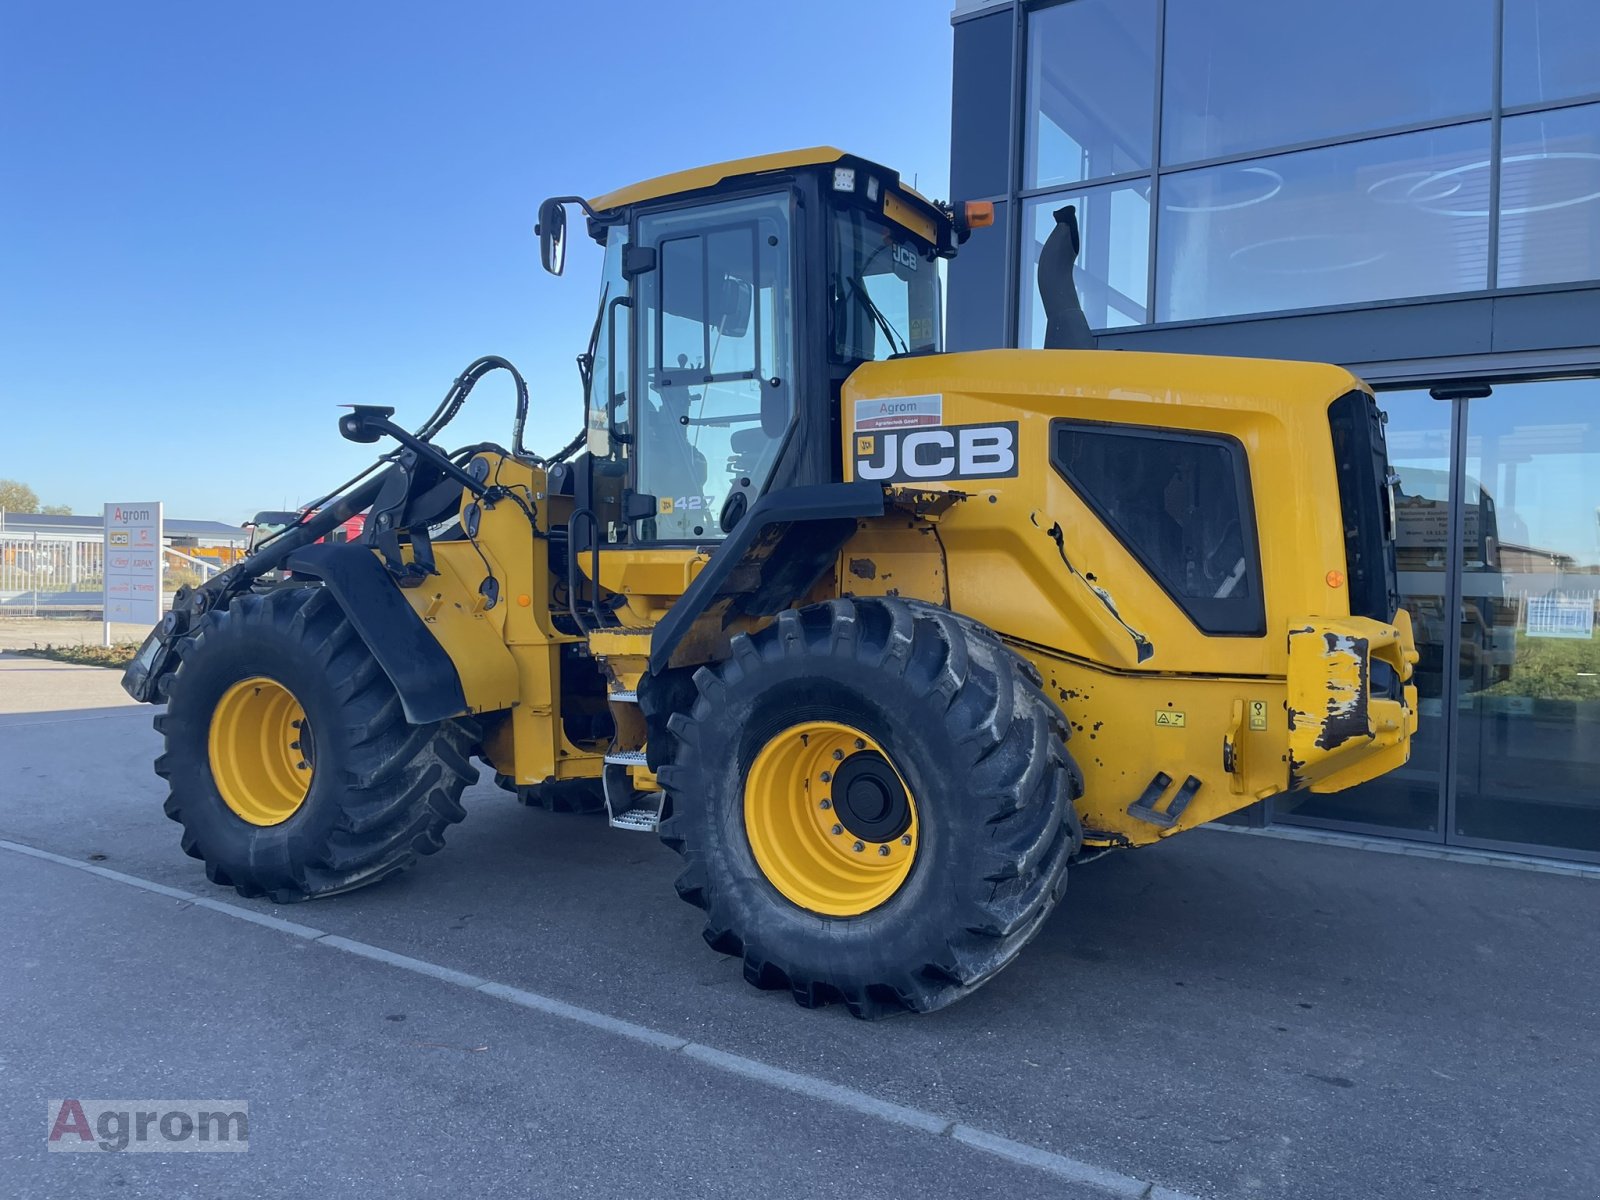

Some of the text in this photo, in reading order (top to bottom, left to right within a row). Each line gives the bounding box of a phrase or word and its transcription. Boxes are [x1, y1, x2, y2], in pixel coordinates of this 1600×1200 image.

[893, 246, 917, 271] JCB
[880, 402, 917, 415] Agrom
[857, 426, 1014, 480] JCB
[674, 496, 715, 510] 427
[114, 506, 150, 524] Agrom
[111, 534, 128, 544] JCB
